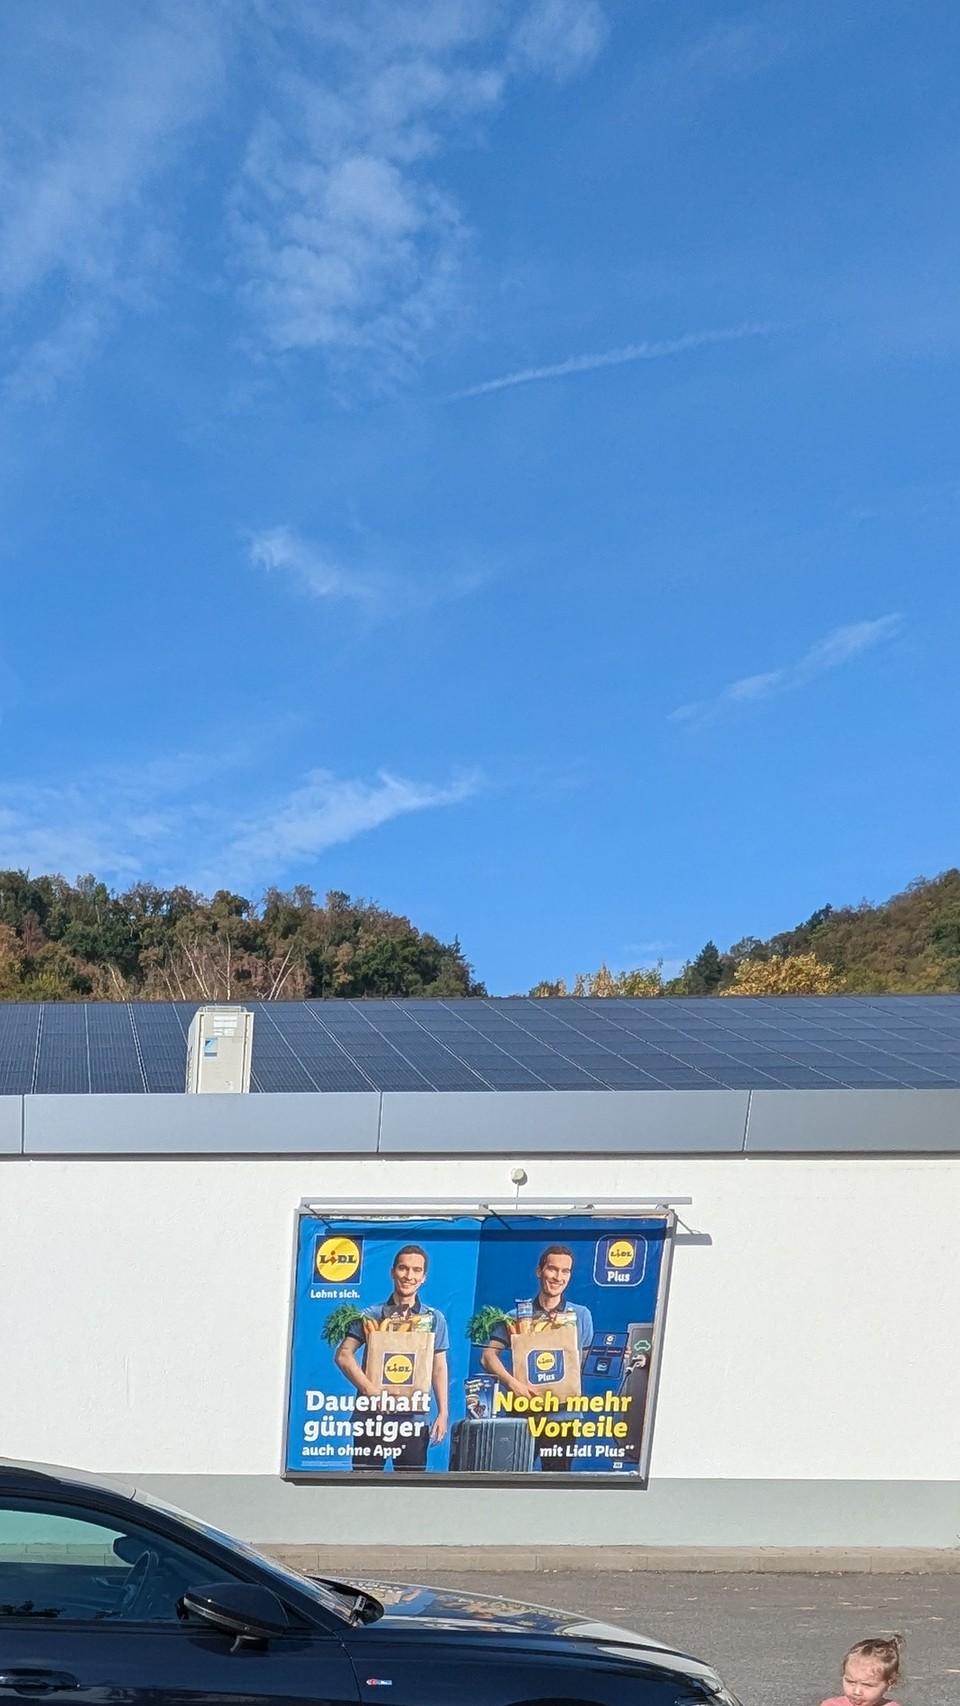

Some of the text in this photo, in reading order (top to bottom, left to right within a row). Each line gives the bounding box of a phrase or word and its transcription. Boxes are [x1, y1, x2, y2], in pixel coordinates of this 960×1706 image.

[607, 1271, 630, 1282] Plus
[310, 1289, 360, 1299] Lohnt sich.
[306, 1390, 431, 1412] Dauerhaft
[495, 1391, 633, 1412] Noch mehr
[304, 1415, 424, 1442] günstiger
[528, 1416, 628, 1438] Vorteile
[302, 1444, 334, 1456] auch
[338, 1444, 371, 1456] ohne
[540, 1444, 563, 1457] mit
[566, 1445, 592, 1457] Lidl
